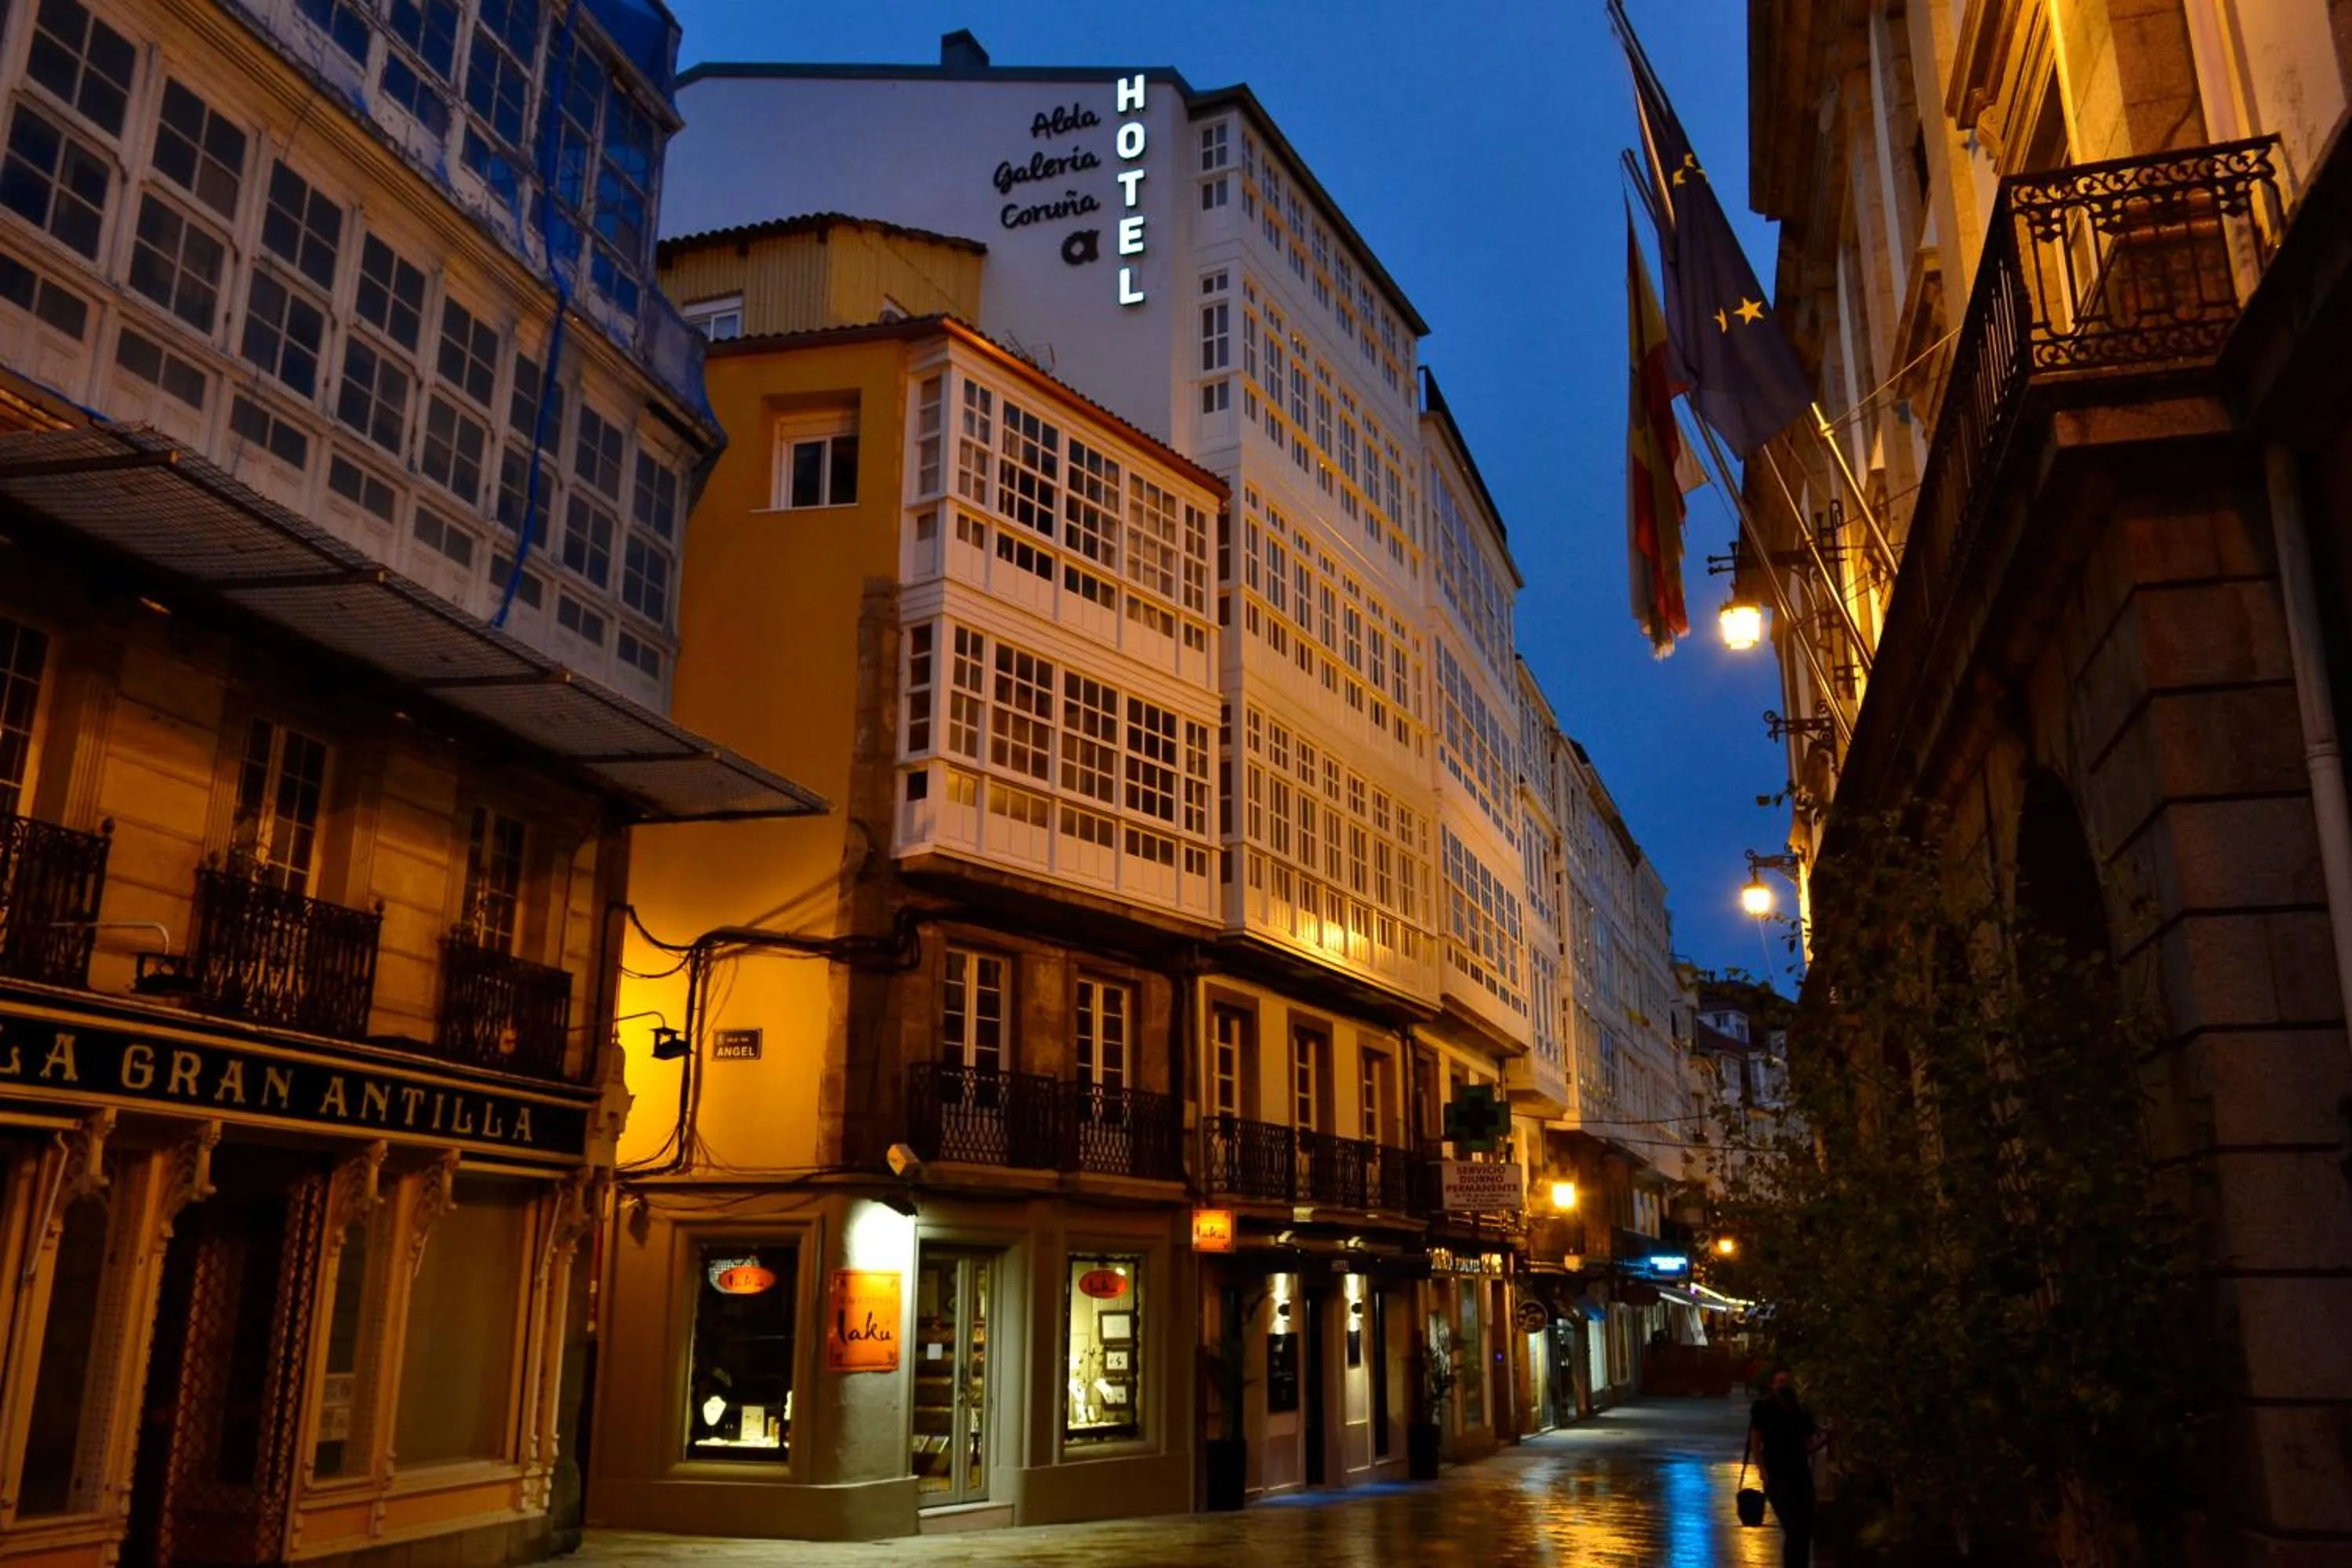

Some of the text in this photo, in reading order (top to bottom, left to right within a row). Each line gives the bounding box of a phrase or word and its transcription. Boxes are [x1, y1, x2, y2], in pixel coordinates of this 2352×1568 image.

[1030, 102, 1102, 140] Alda
[1116, 74, 1146, 307] HOTEL
[1000, 190, 1102, 230] Coruña
[121, 1044, 294, 1109] GRAN
[318, 1076, 533, 1142] ANTILLA
[1445, 1184, 1519, 1192] PERMANENTE
[1456, 1166, 1506, 1175] SERVICIO
[1459, 1175, 1504, 1184] DIURNO
